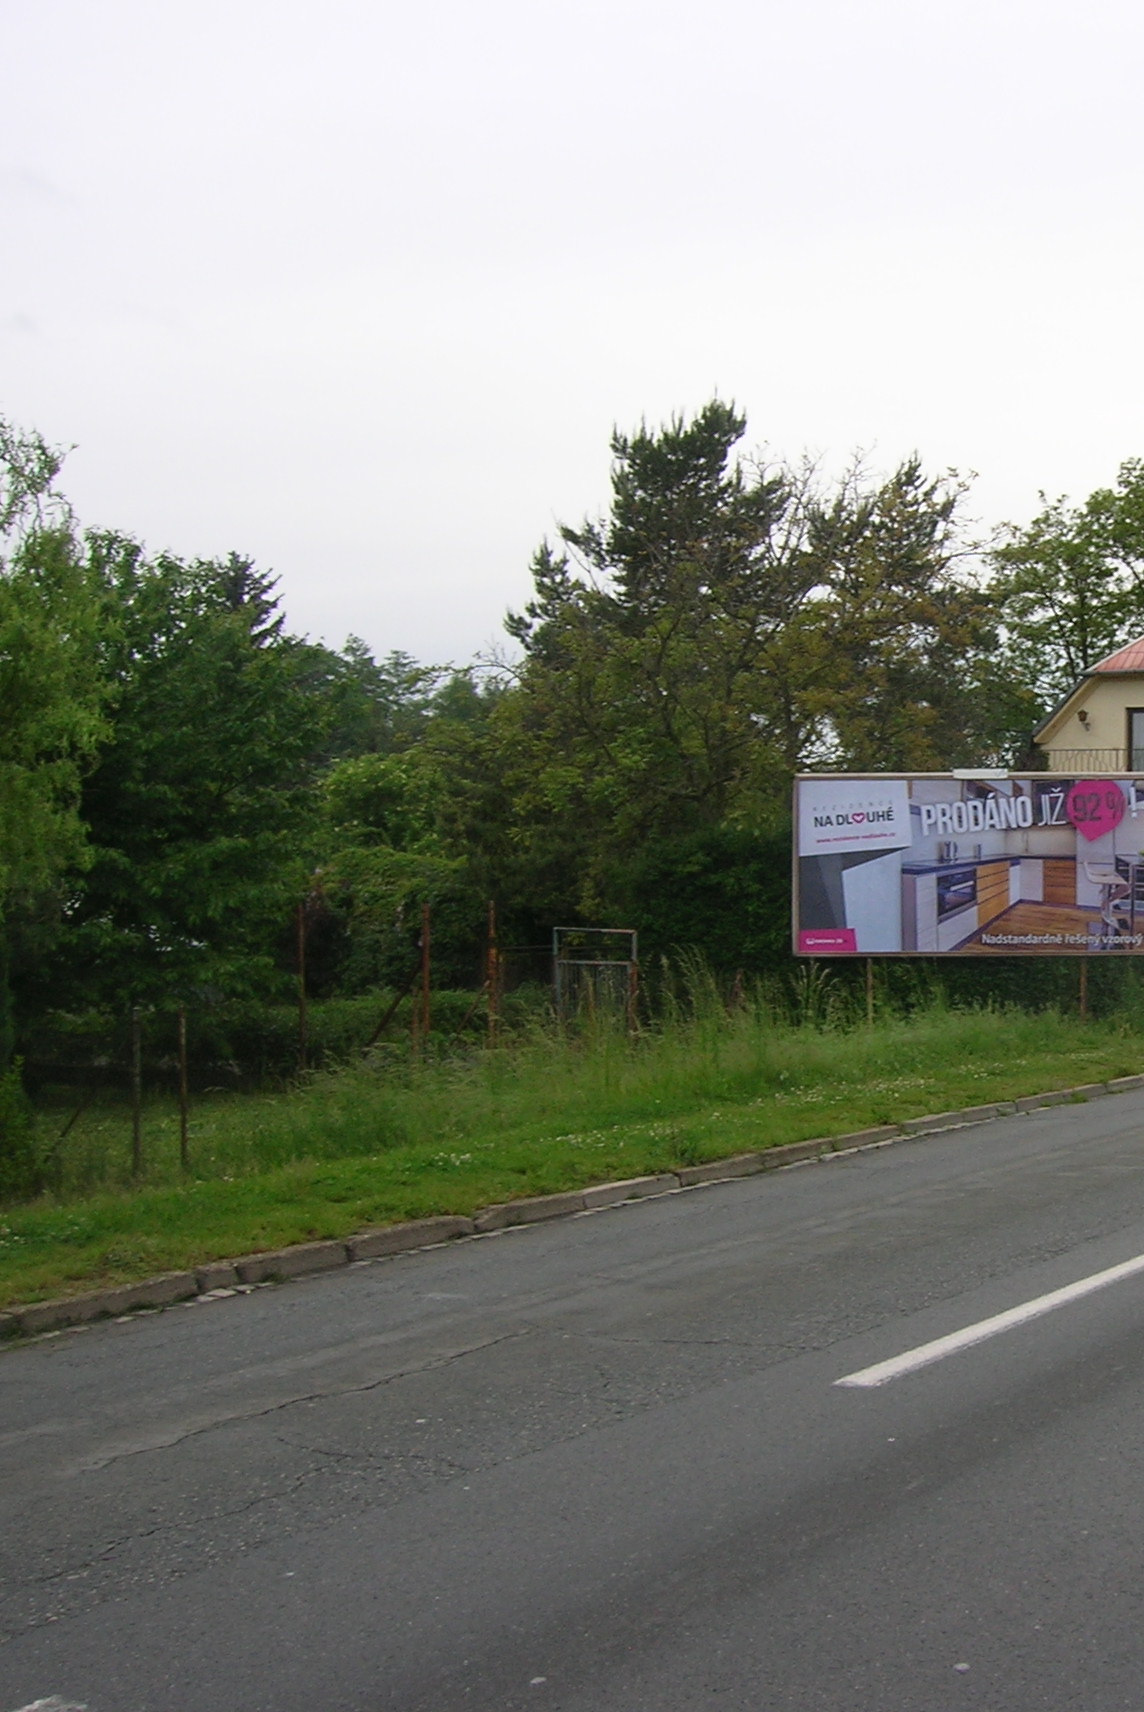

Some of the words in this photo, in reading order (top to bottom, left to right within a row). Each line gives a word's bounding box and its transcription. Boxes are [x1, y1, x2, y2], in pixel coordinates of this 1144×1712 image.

[921, 793, 1033, 836] PRODÁNO
[1038, 787, 1067, 827] JIŽ
[1072, 794, 1102, 822] 92
[814, 815, 833, 828] NA
[982, 933, 1063, 944] Nadstandardně
[1065, 933, 1100, 946] řešený
[1102, 933, 1144, 946] vzorový
